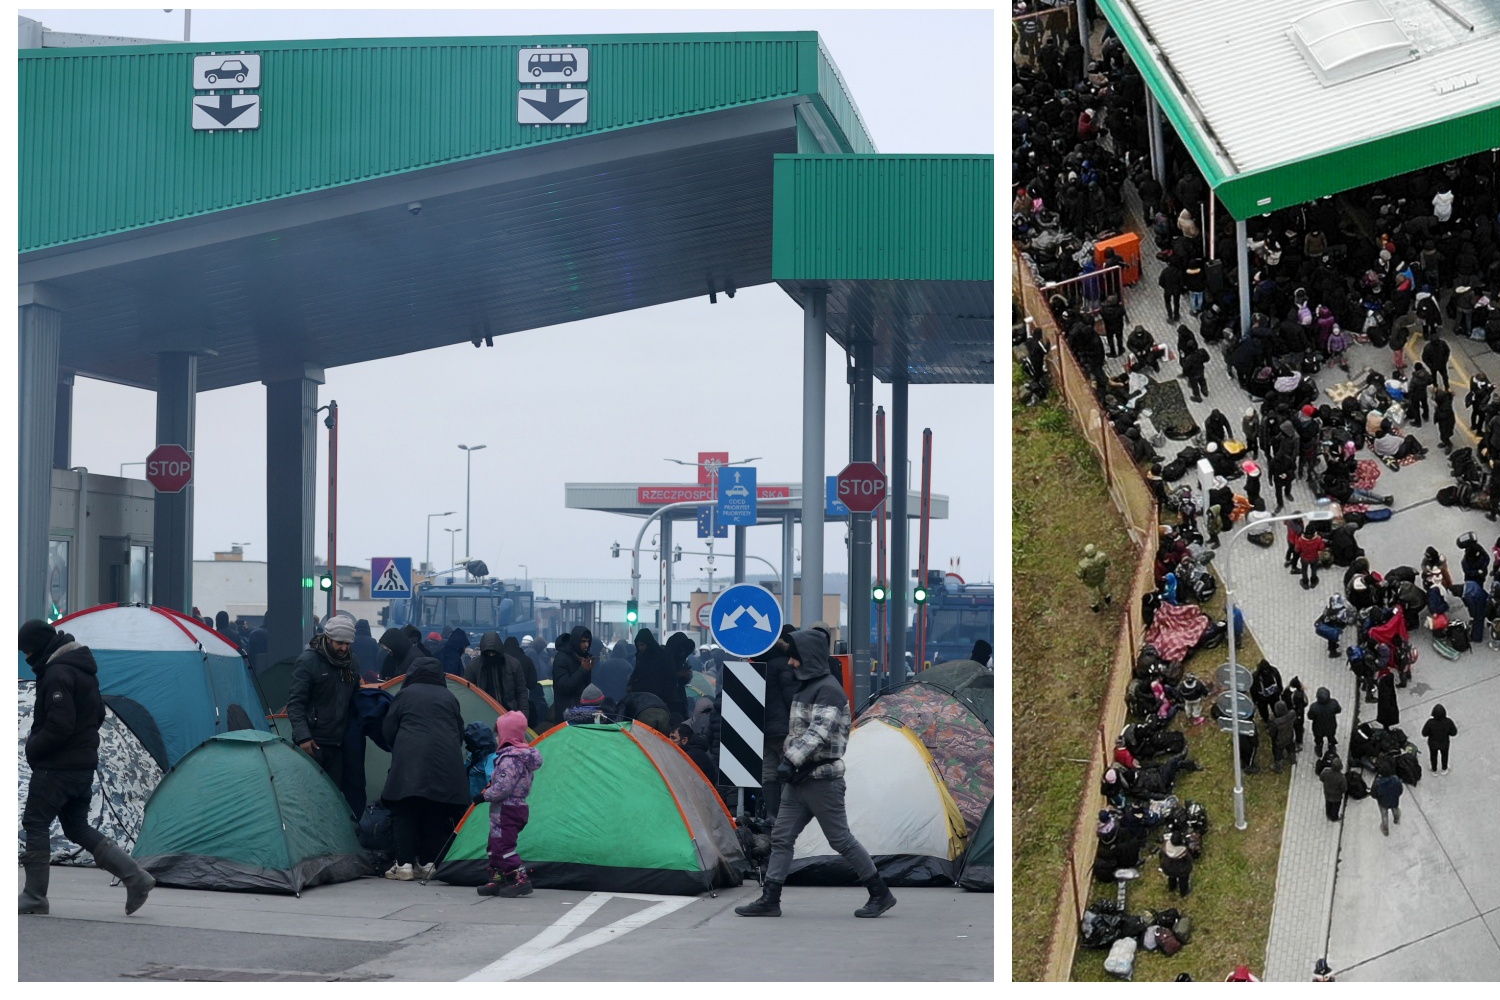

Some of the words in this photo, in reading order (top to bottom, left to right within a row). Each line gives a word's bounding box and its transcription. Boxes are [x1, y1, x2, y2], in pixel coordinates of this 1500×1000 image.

[149, 461, 190, 477] STOP
[641, 490, 718, 500] RZECZPOSPOL
[839, 479, 885, 495] STOP
